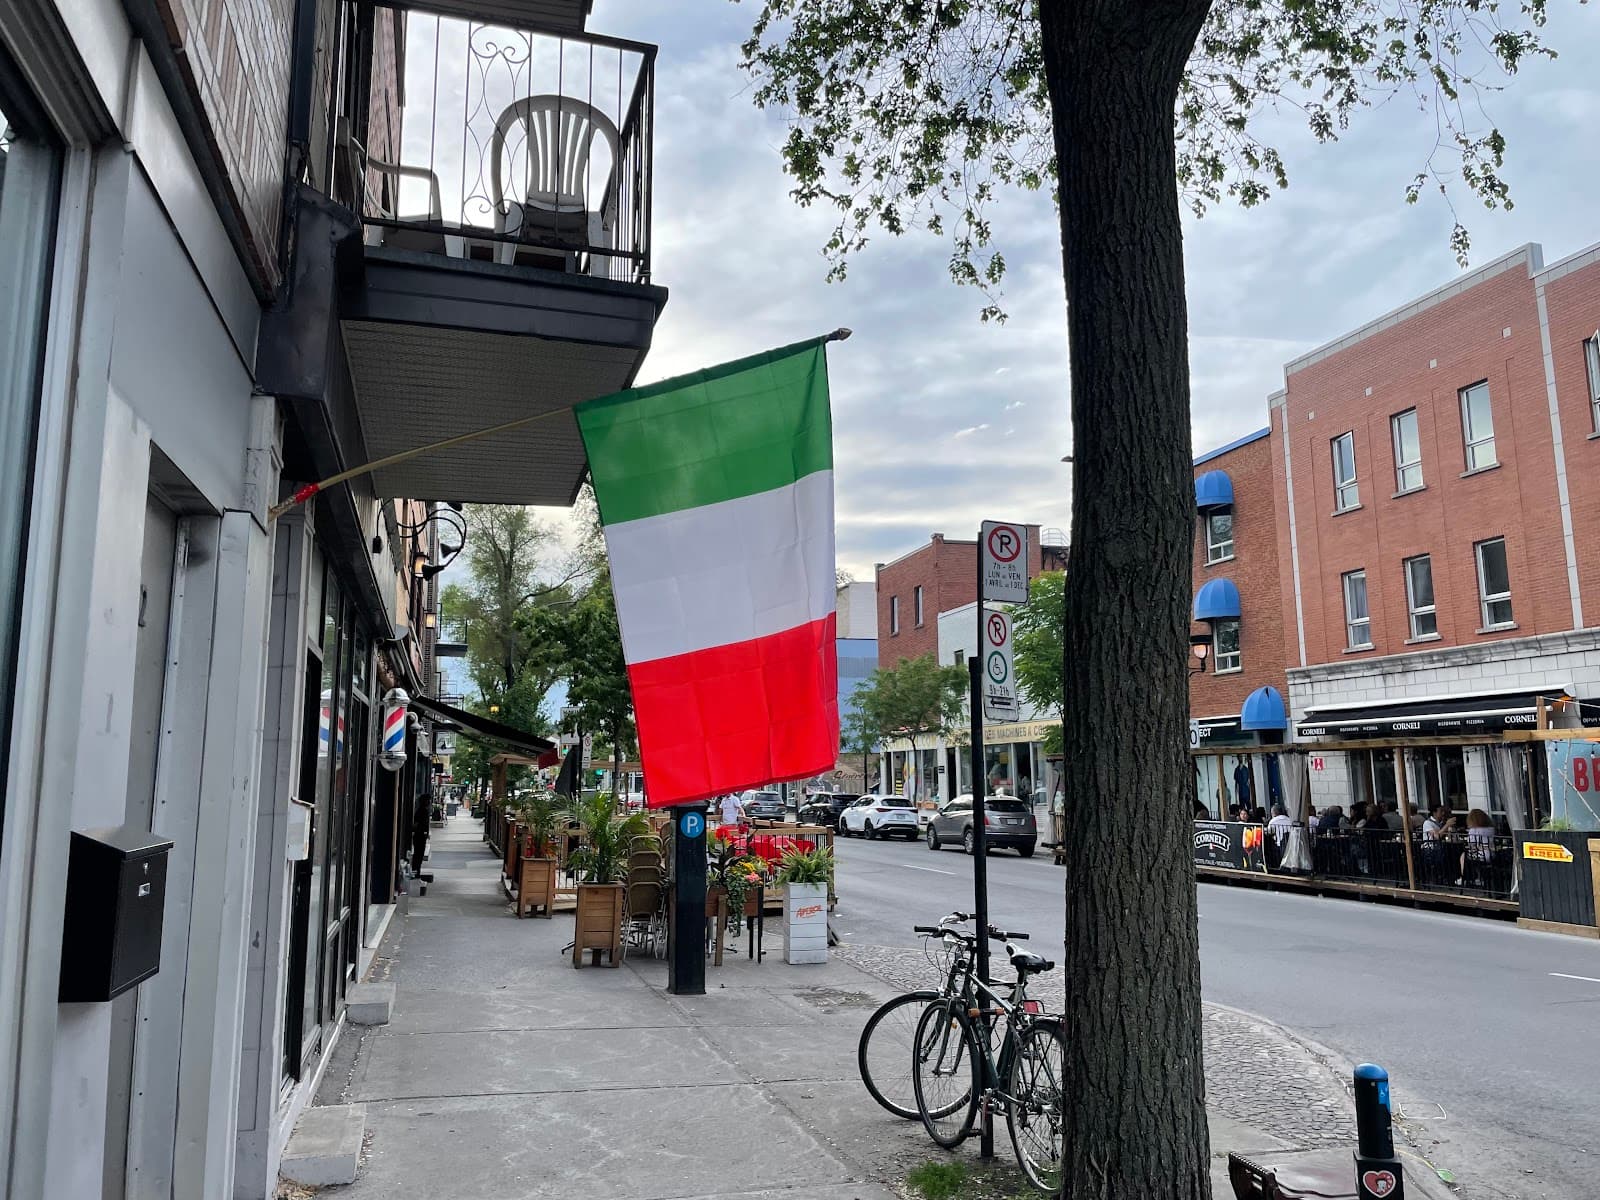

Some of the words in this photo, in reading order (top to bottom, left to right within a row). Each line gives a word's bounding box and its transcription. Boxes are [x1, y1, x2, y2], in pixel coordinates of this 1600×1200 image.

[988, 570, 1000, 578] LUN
[1008, 572, 1021, 580] VEN
[1504, 714, 1538, 724] CORNEL
[1392, 721, 1420, 731] CORNELI
[1199, 727, 1212, 738] ECT
[1302, 727, 1326, 736] CORNELI
[1195, 833, 1227, 848] CORNELI
